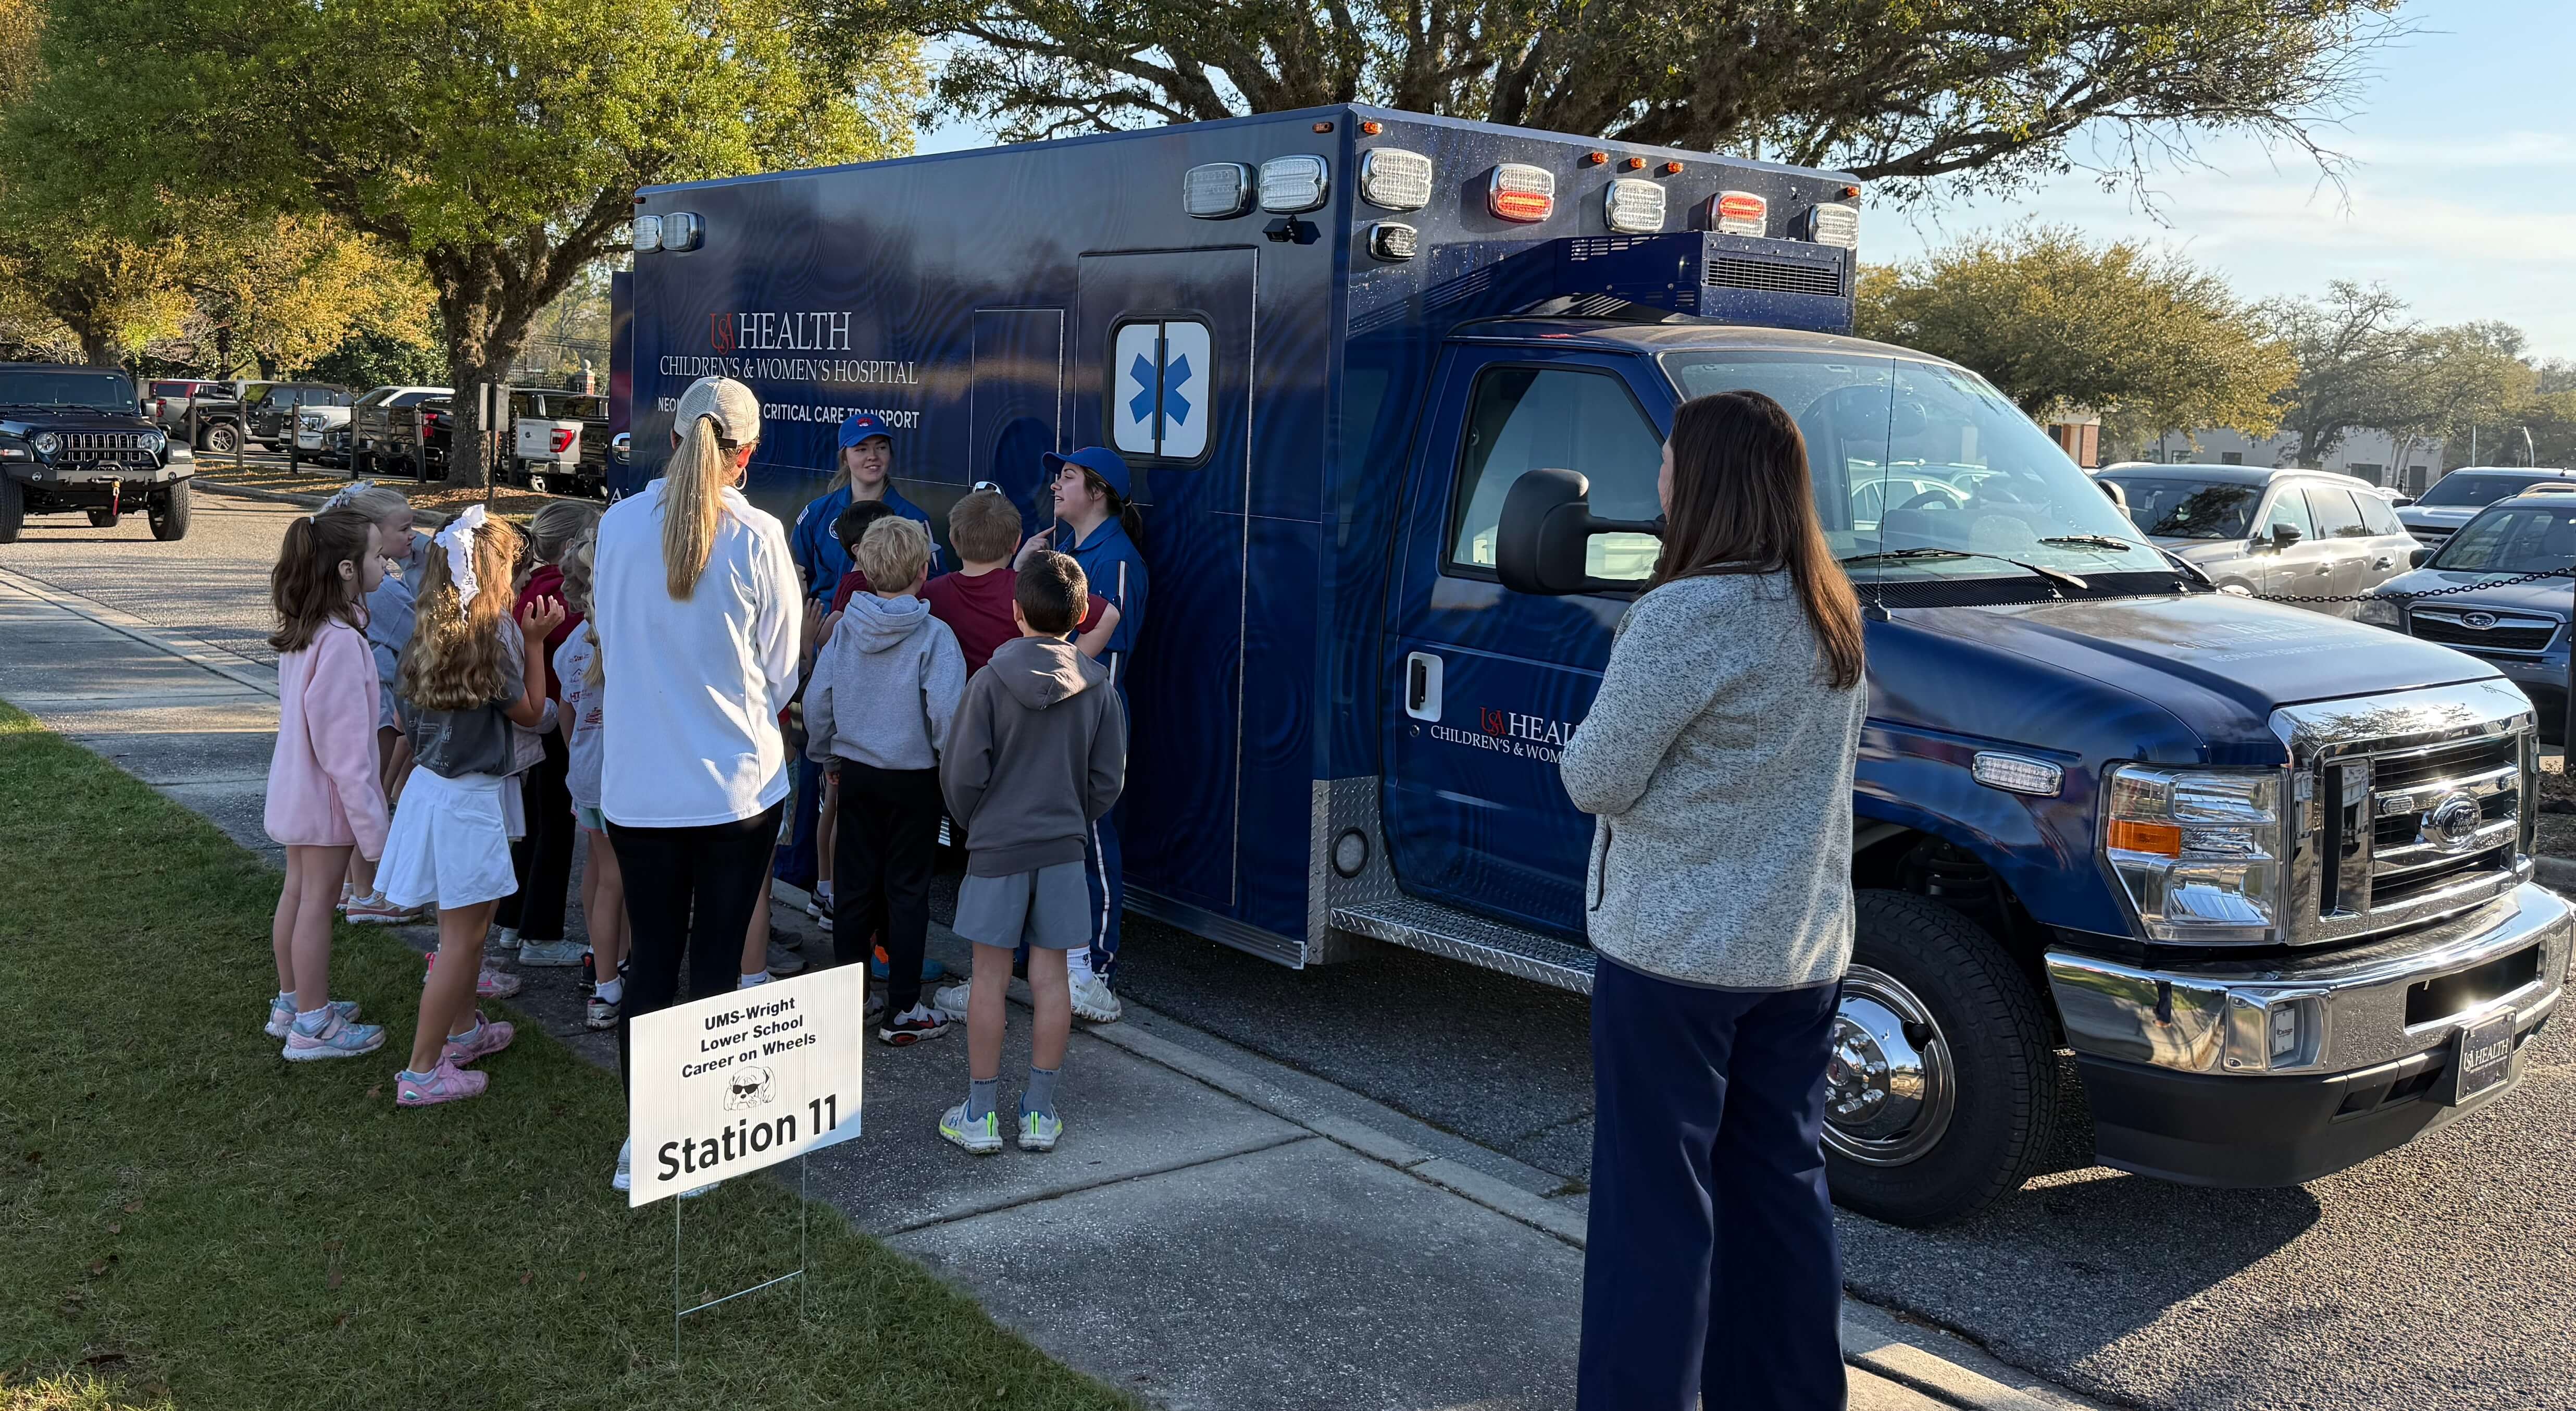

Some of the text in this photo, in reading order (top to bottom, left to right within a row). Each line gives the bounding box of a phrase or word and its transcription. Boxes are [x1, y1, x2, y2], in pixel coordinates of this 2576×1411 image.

[738, 312, 852, 350] HEALTH
[659, 355, 918, 384] CHILDREN'S & WOMEN'S HOSPITAL
[763, 403, 812, 422] CRITICAL
[814, 405, 844, 424] CARE
[1430, 725, 1510, 753] CHILDREN'S
[1513, 742, 1524, 756] &
[1508, 712, 1574, 747] HEAL
[705, 997, 795, 1030] UMS-Wright
[701, 1014, 803, 1053] Lower School
[682, 1032, 816, 1078] Career on Wheels
[2475, 1038, 2509, 1067] HEALTH
[657, 1093, 836, 1181] Station 11
